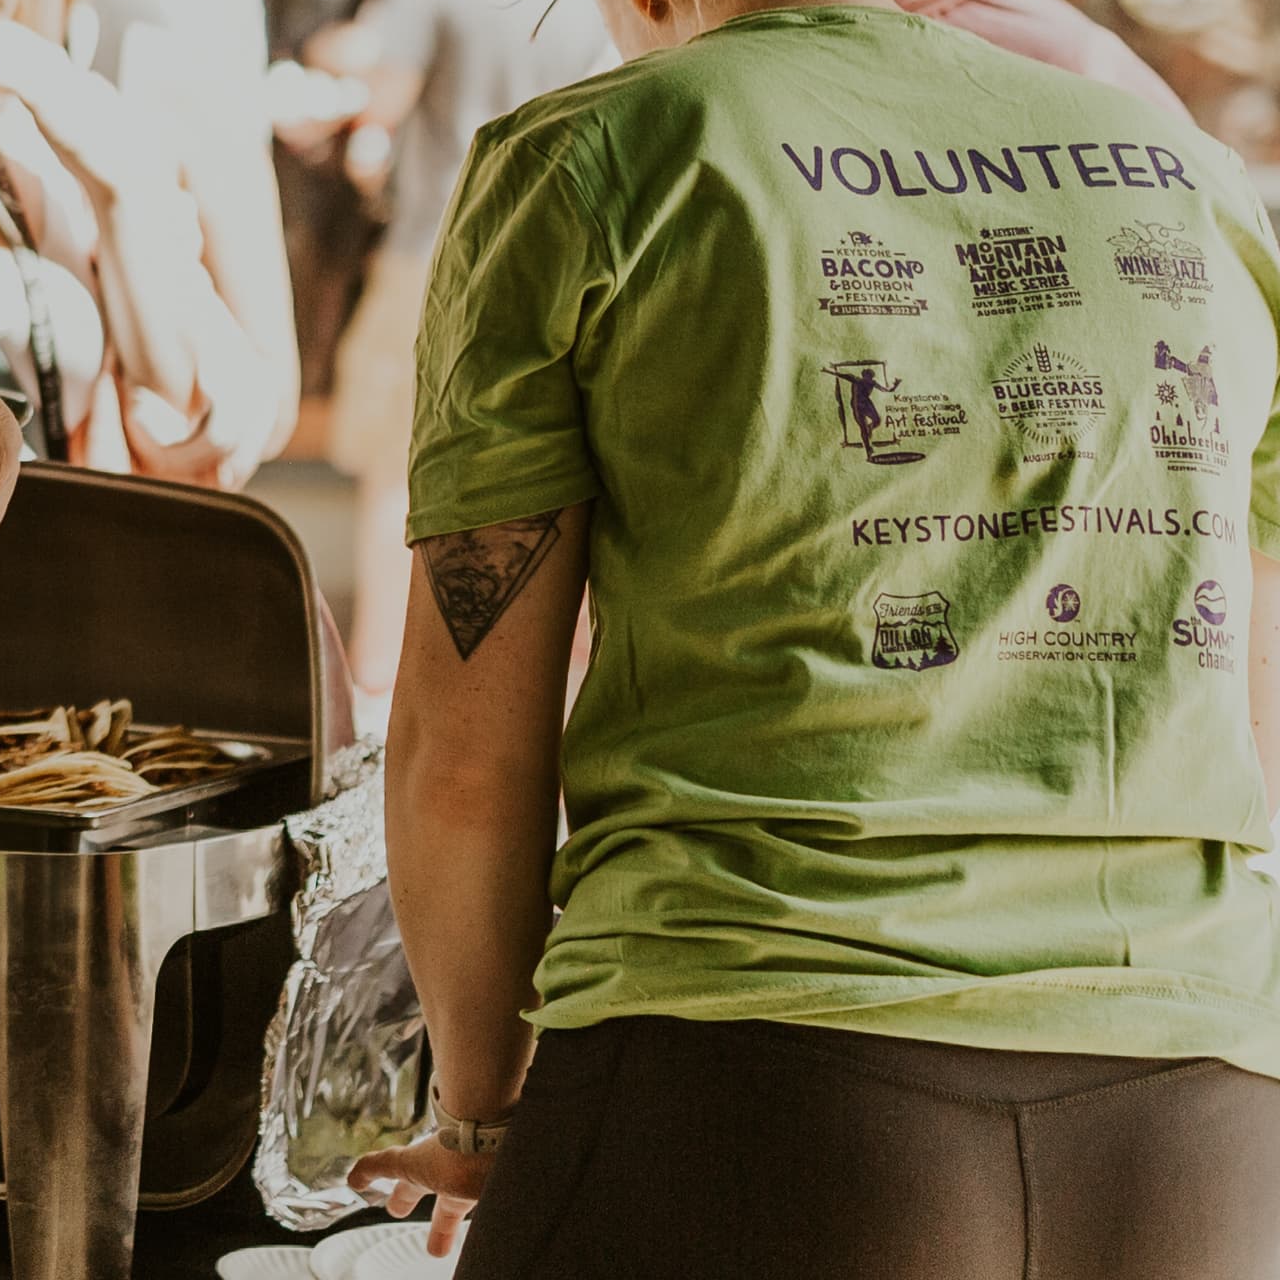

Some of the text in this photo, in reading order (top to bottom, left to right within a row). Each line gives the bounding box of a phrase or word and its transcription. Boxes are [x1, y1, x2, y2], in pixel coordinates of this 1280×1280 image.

[781, 142, 1197, 197] VOLUNTEER
[836, 249, 892, 258] KEYSTONE
[955, 235, 1067, 266] MOUNTAIN
[821, 258, 924, 279] BACON
[1115, 255, 1208, 281] WINE JAZZ
[973, 274, 1070, 296] MUSIC SERIES
[845, 293, 902, 302] FESTIVAL
[972, 301, 993, 309] JULY
[977, 307, 1017, 317] AUGUST
[894, 393, 949, 403] Keystone's
[993, 382, 1103, 400] BLUEGRASS
[998, 399, 1105, 413] & BEER FESTIVAL
[885, 414, 907, 429] Art
[1023, 452, 1056, 463] AUGUST
[852, 506, 1238, 546] KEYSTONEFESTIVALS.COM
[880, 602, 925, 617] Friends
[881, 626, 933, 648] DILLON
[999, 631, 1137, 647] HIGH COUNTRY
[997, 651, 1137, 661] CONSERVATION CENTER
